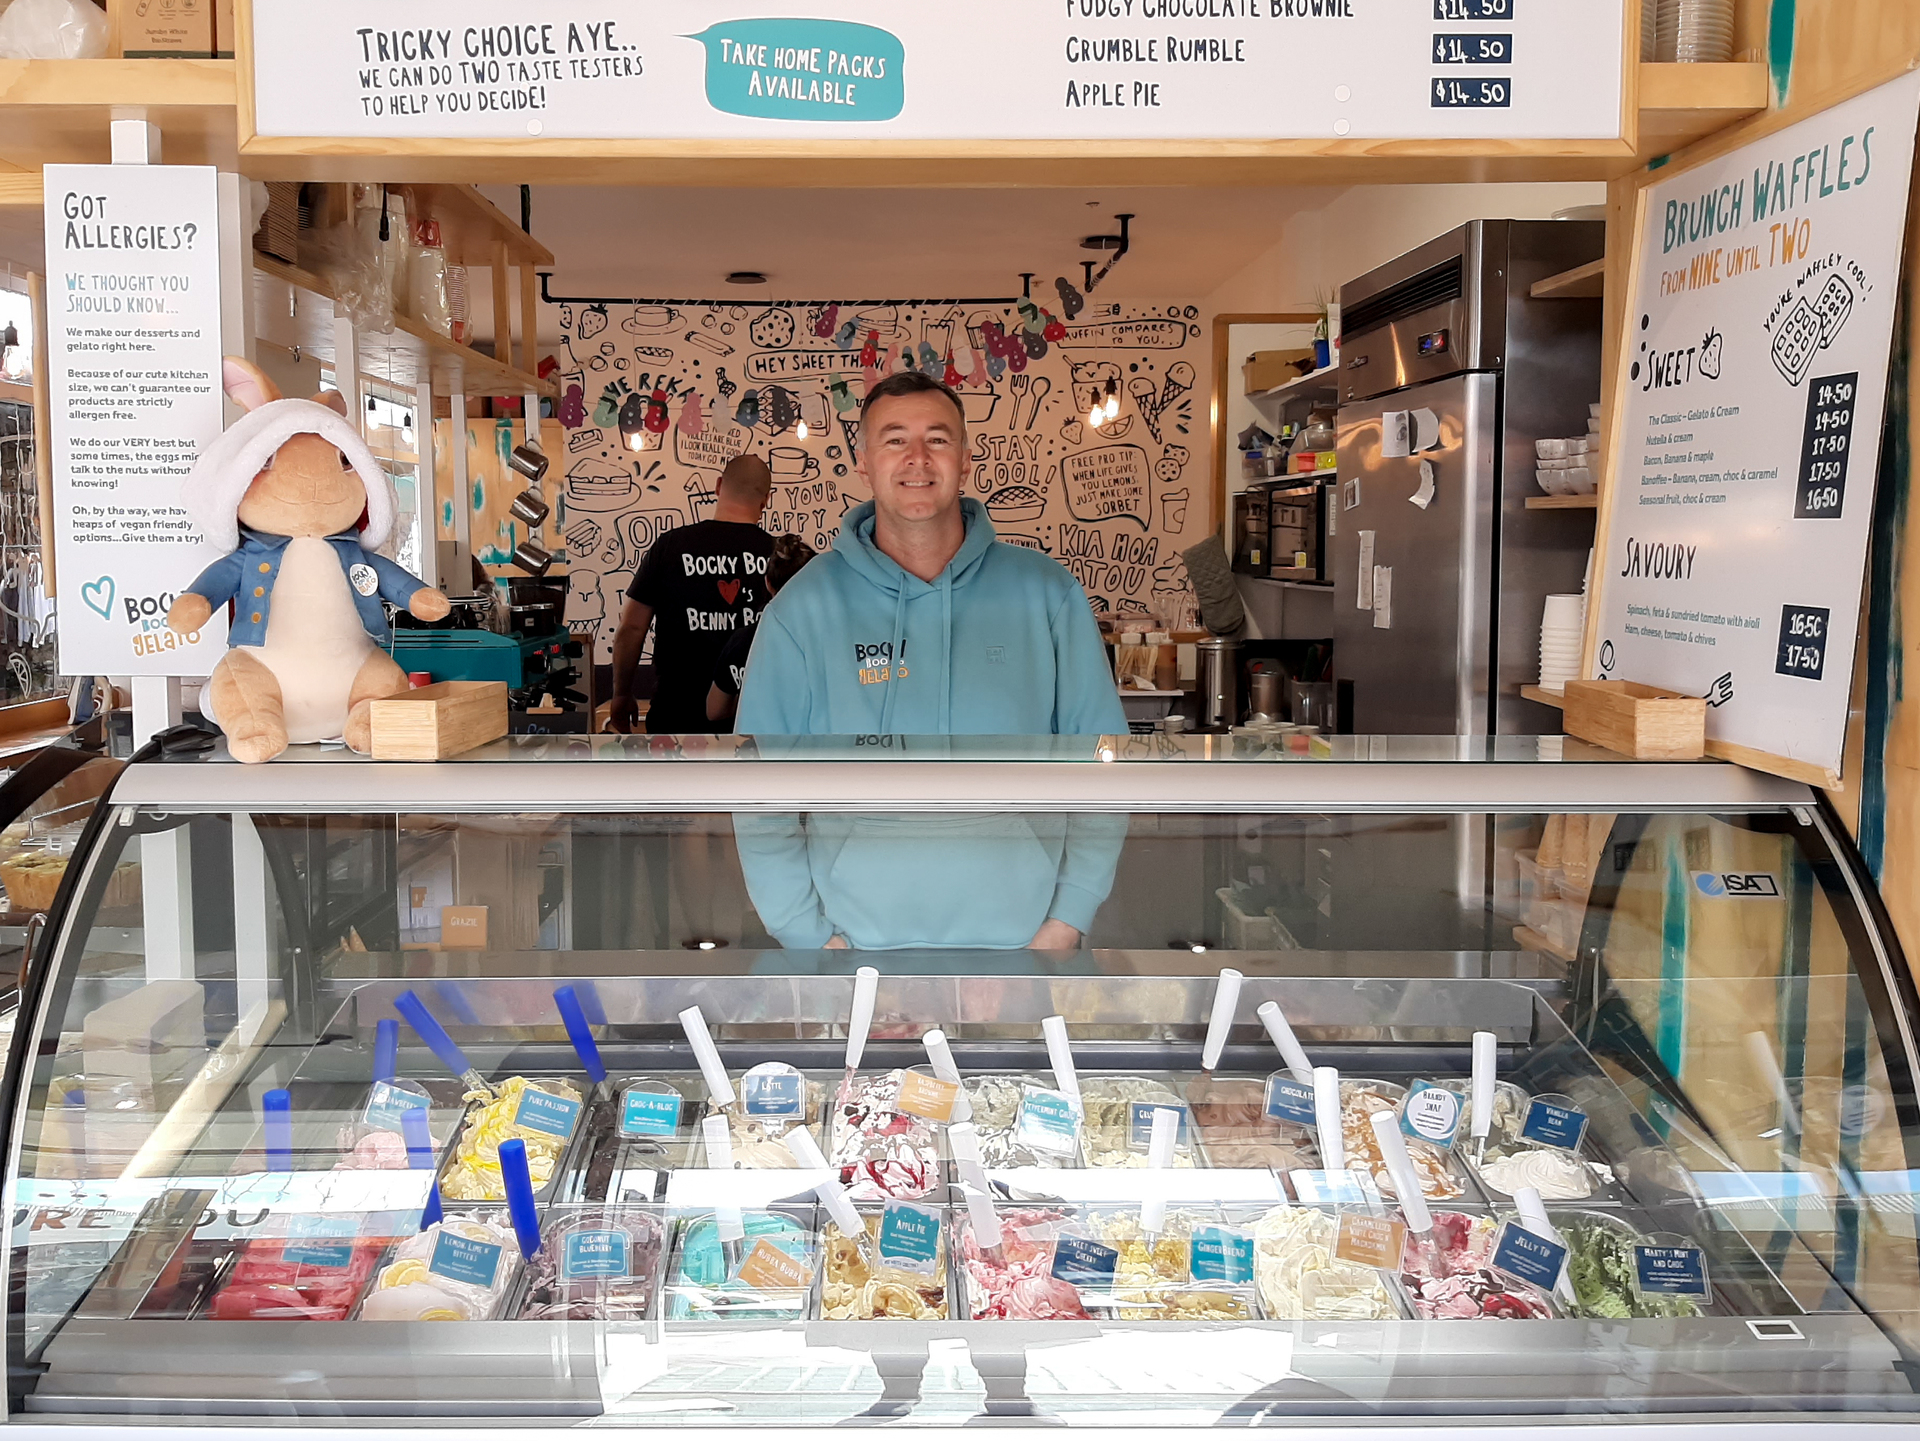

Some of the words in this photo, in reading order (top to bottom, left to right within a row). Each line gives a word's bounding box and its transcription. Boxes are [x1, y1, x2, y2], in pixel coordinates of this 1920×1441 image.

[357, 27, 453, 63] TRICKY
[465, 23, 556, 58] CHOICE
[567, 20, 638, 54] AYE..
[1066, 36, 1158, 63] CRUMBLE
[1167, 36, 1245, 62] RUMBLE
[1436, 37, 1504, 64] $14.50
[720, 38, 767, 67] TAKE
[774, 47, 821, 73] HOME
[828, 50, 886, 79] PACKS
[359, 69, 383, 89] WE
[389, 66, 423, 87] CAN
[430, 65, 453, 86] DO
[459, 62, 500, 84] TWO
[507, 59, 562, 83] TASTE
[569, 55, 644, 79] TESTERS
[748, 70, 856, 106] AVAILABLE
[1066, 81, 1125, 107] APPLE
[1133, 81, 1161, 107] PIE
[1436, 80, 1505, 104] $14.50
[361, 96, 383, 116] TO
[389, 94, 429, 115] HELP
[436, 92, 472, 113] YOU
[478, 86, 547, 111] DECIDE!
[1664, 179, 1744, 254] BRUNCH
[1753, 126, 1874, 223] WAFFLES
[64, 192, 107, 220] GOT
[65, 221, 197, 250] ALLERGIES?
[1660, 267, 1686, 297] FROM
[1689, 248, 1722, 291] NINE
[1726, 245, 1760, 278] UNTIL
[1769, 217, 1810, 268] TWO
[65, 273, 86, 291] WE
[91, 275, 154, 291] THOUGHT
[160, 276, 189, 291] YOU
[1797, 253, 1842, 288] WAFFLEY
[1847, 260, 1873, 303] COOL!
[66, 294, 121, 313] SHOULD
[127, 297, 179, 314] KNOW...
[66, 328, 83, 337] We
[85, 328, 112, 337] make
[114, 330, 132, 338] our
[134, 329, 179, 338] desserts
[181, 329, 200, 338] and
[67, 342, 100, 352] gelato
[101, 342, 127, 353] right
[128, 343, 156, 352] here.
[67, 369, 111, 379] Because
[113, 369, 124, 379] of
[125, 371, 143, 379] our
[145, 370, 168, 380] cute
[170, 370, 209, 380] kitchen
[755, 355, 785, 373] HEY
[793, 354, 836, 370] SWEET
[1642, 347, 1696, 392] SWEET
[68, 384, 92, 394] size,
[94, 385, 109, 393] we
[111, 383, 137, 393] can't
[138, 386, 191, 395] guarantee
[68, 397, 115, 408] products
[117, 398, 134, 407] are
[136, 398, 173, 408] strictly
[69, 411, 111, 422] allergen
[112, 411, 137, 420] free.
[1648, 415, 1660, 426] The
[1660, 412, 1682, 424] Classic
[1687, 409, 1709, 421] Gelato
[1716, 405, 1740, 417] Cream
[70, 438, 87, 447] We
[89, 438, 101, 447] do
[103, 439, 121, 447] our
[123, 438, 151, 447] VERY
[153, 439, 176, 448] best
[178, 439, 196, 448] but
[972, 433, 1042, 461] STAY
[1646, 433, 1667, 446] Nutella
[1673, 433, 1693, 443] cream
[71, 465, 90, 475] talk
[92, 465, 104, 475] to
[105, 466, 123, 475] the
[125, 467, 149, 475] nuts
[151, 466, 191, 475] without
[1071, 456, 1095, 468] FREE
[1098, 453, 1115, 465] PRO
[973, 463, 1057, 494] COOL!
[1073, 469, 1095, 481] WHEN
[1097, 467, 1113, 477] LIFE
[1116, 464, 1137, 474] GIVES
[71, 478, 118, 490] knowing!
[784, 480, 838, 510] YOUR
[1082, 481, 1099, 490] YOU
[1076, 491, 1097, 505] JUST
[1100, 489, 1121, 499] MAKE
[1124, 487, 1143, 496] SOME
[1096, 499, 1140, 516] SORBET
[72, 520, 104, 531] heaps
[105, 520, 117, 530] of
[120, 522, 151, 532] vegan
[153, 520, 193, 531] friendly
[148, 534, 175, 543] them
[185, 534, 204, 544] try!
[1060, 524, 1104, 558] KIA
[682, 553, 738, 576] BOCKY
[1621, 537, 1697, 580] SAVOURY
[686, 607, 737, 631] BENNY
[1722, 874, 1762, 891] ISA
